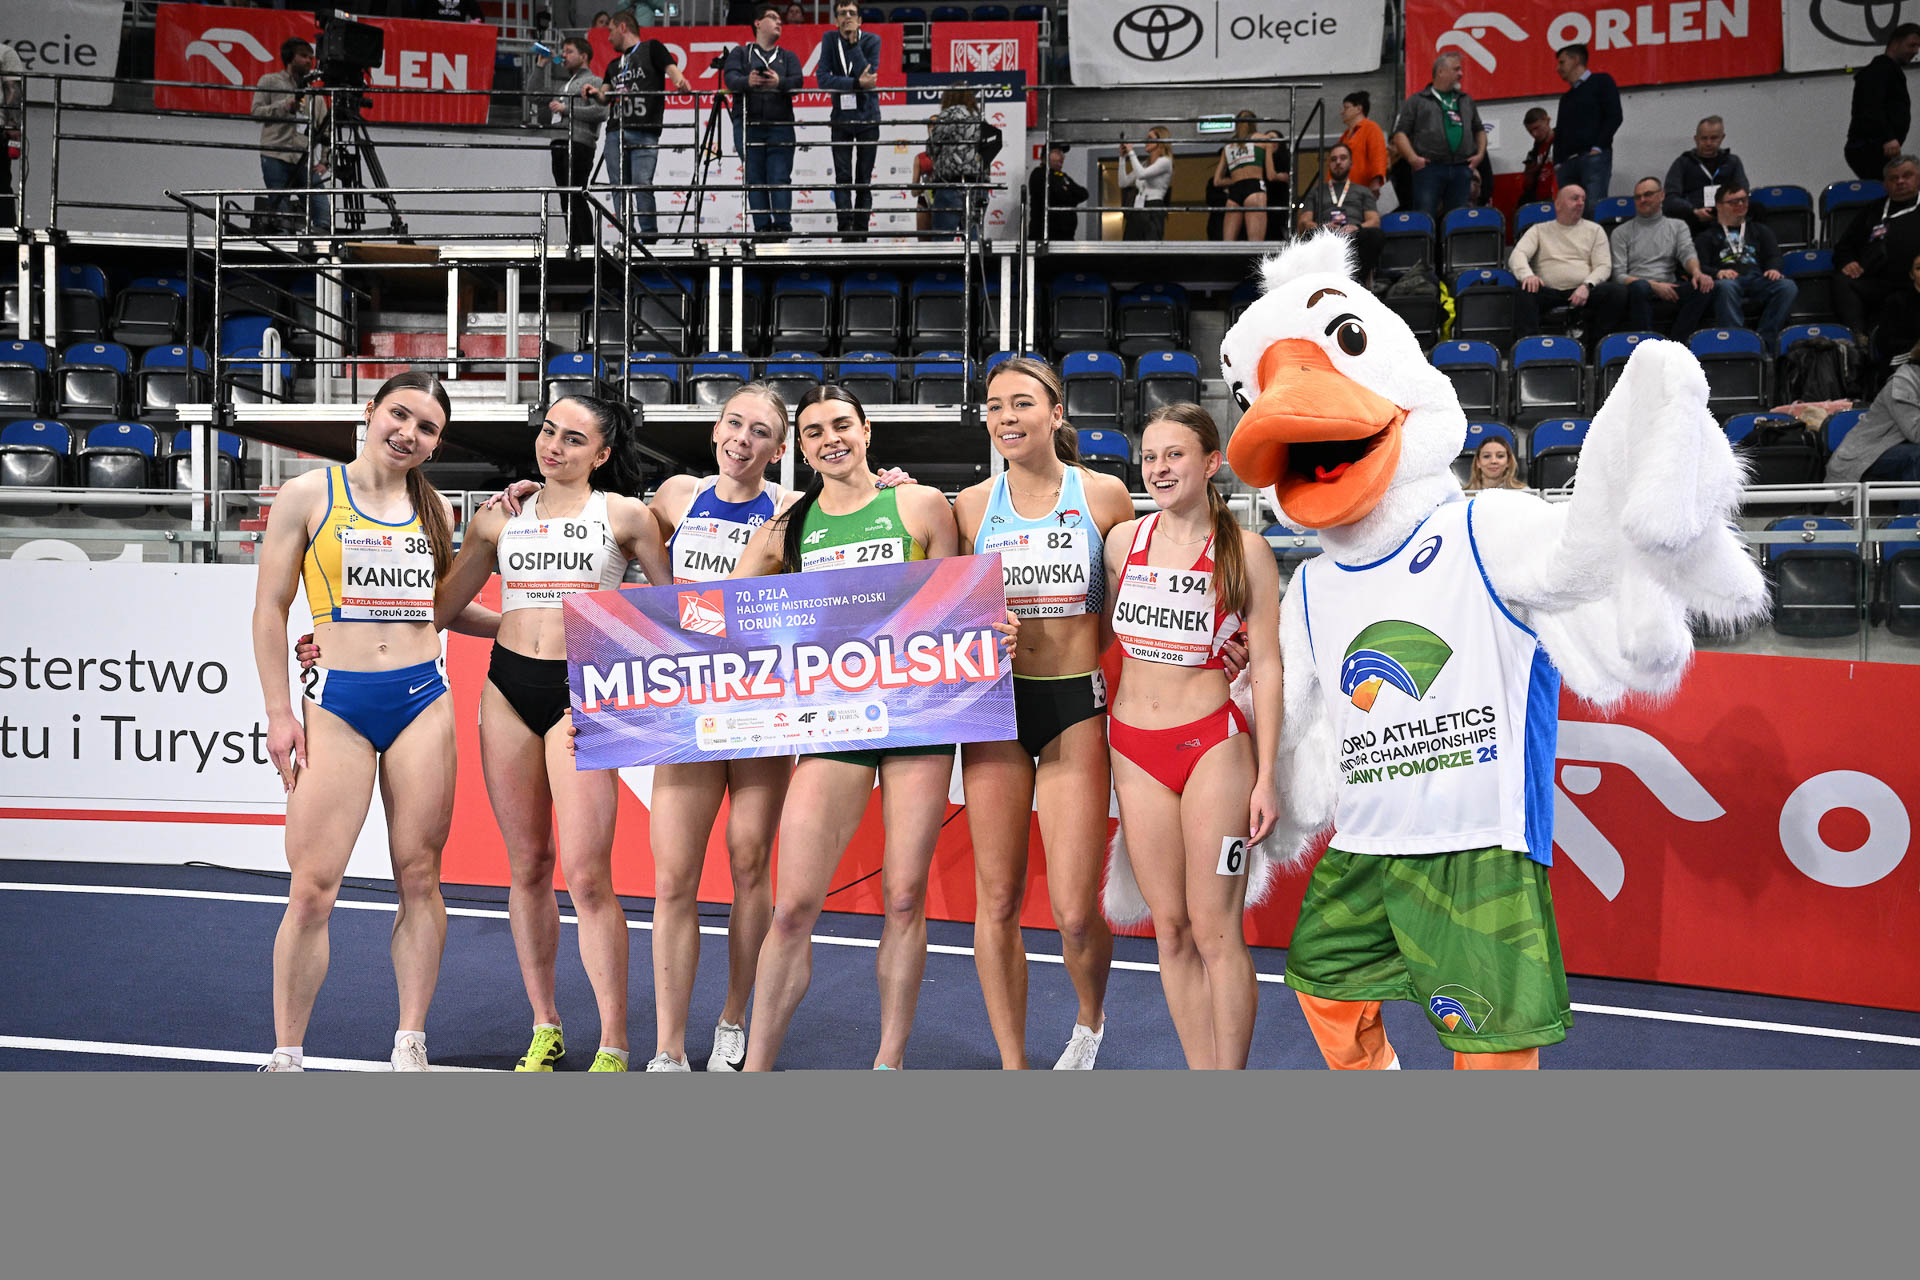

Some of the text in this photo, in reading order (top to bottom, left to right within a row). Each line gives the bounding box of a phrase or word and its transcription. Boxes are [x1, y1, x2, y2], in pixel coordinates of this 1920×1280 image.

[1230, 11, 1337, 44] Okęcie
[1547, 0, 1749, 52] ORLEN
[3, 33, 97, 70] ęcie
[364, 49, 468, 90] LEN
[344, 537, 382, 546] InterRisk
[564, 523, 588, 539] 80
[1048, 532, 1072, 549] 82
[857, 544, 894, 563] 278
[986, 540, 1018, 549] InterRisk
[508, 552, 594, 571] OSIPIUK
[804, 556, 834, 567] InterRisk
[347, 566, 435, 588] KANICK
[1169, 575, 1206, 595] 194
[526, 590, 554, 598] TORUŃ
[736, 588, 789, 603] 70. PZLA
[736, 592, 886, 615] HALOWE MISTRZOSTWA POLSKI
[369, 608, 402, 616] TORUŃ
[738, 614, 816, 631] TORUŃ 2026
[1116, 602, 1208, 632] SUCHENEK
[1132, 648, 1184, 661] TORUŃ 2026
[0, 647, 228, 694] sterstwo
[582, 629, 997, 709] MISTRZ POLSKI
[300, 667, 319, 699] 2
[1097, 672, 1107, 703] 3
[1382, 706, 1496, 744] ATHLETICS
[0, 713, 281, 775] tu i Turyst
[1371, 727, 1497, 764] CHAMPIONSHIPS
[1346, 767, 1384, 785] JAWY
[1387, 750, 1474, 780] POMORZE
[1227, 840, 1244, 872] 6
